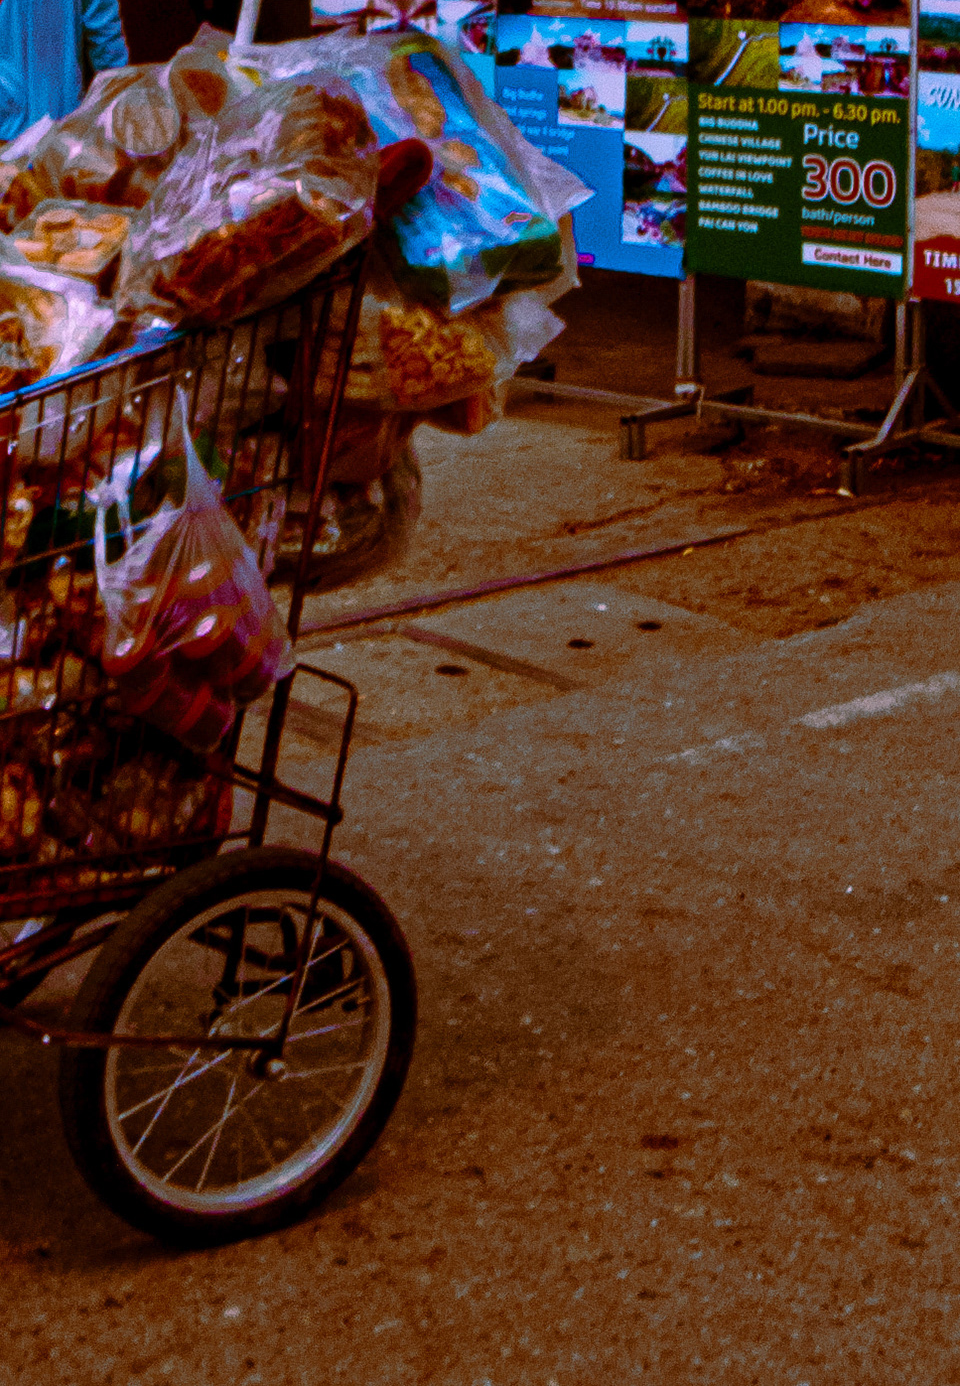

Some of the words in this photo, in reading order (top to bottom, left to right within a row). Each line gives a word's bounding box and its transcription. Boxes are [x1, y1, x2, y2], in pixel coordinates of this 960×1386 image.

[697, 93, 736, 112] Start
[738, 97, 754, 113] at
[757, 97, 789, 116] 1.00
[790, 102, 820, 120] pm.
[832, 103, 867, 121] 6.30
[870, 107, 901, 127] pm.
[740, 136, 782, 151] VILLAGE
[803, 122, 860, 150] Price
[801, 152, 897, 209] 300
[814, 248, 860, 265] Contact
[864, 254, 892, 270] Here
[923, 249, 960, 269] TIM
